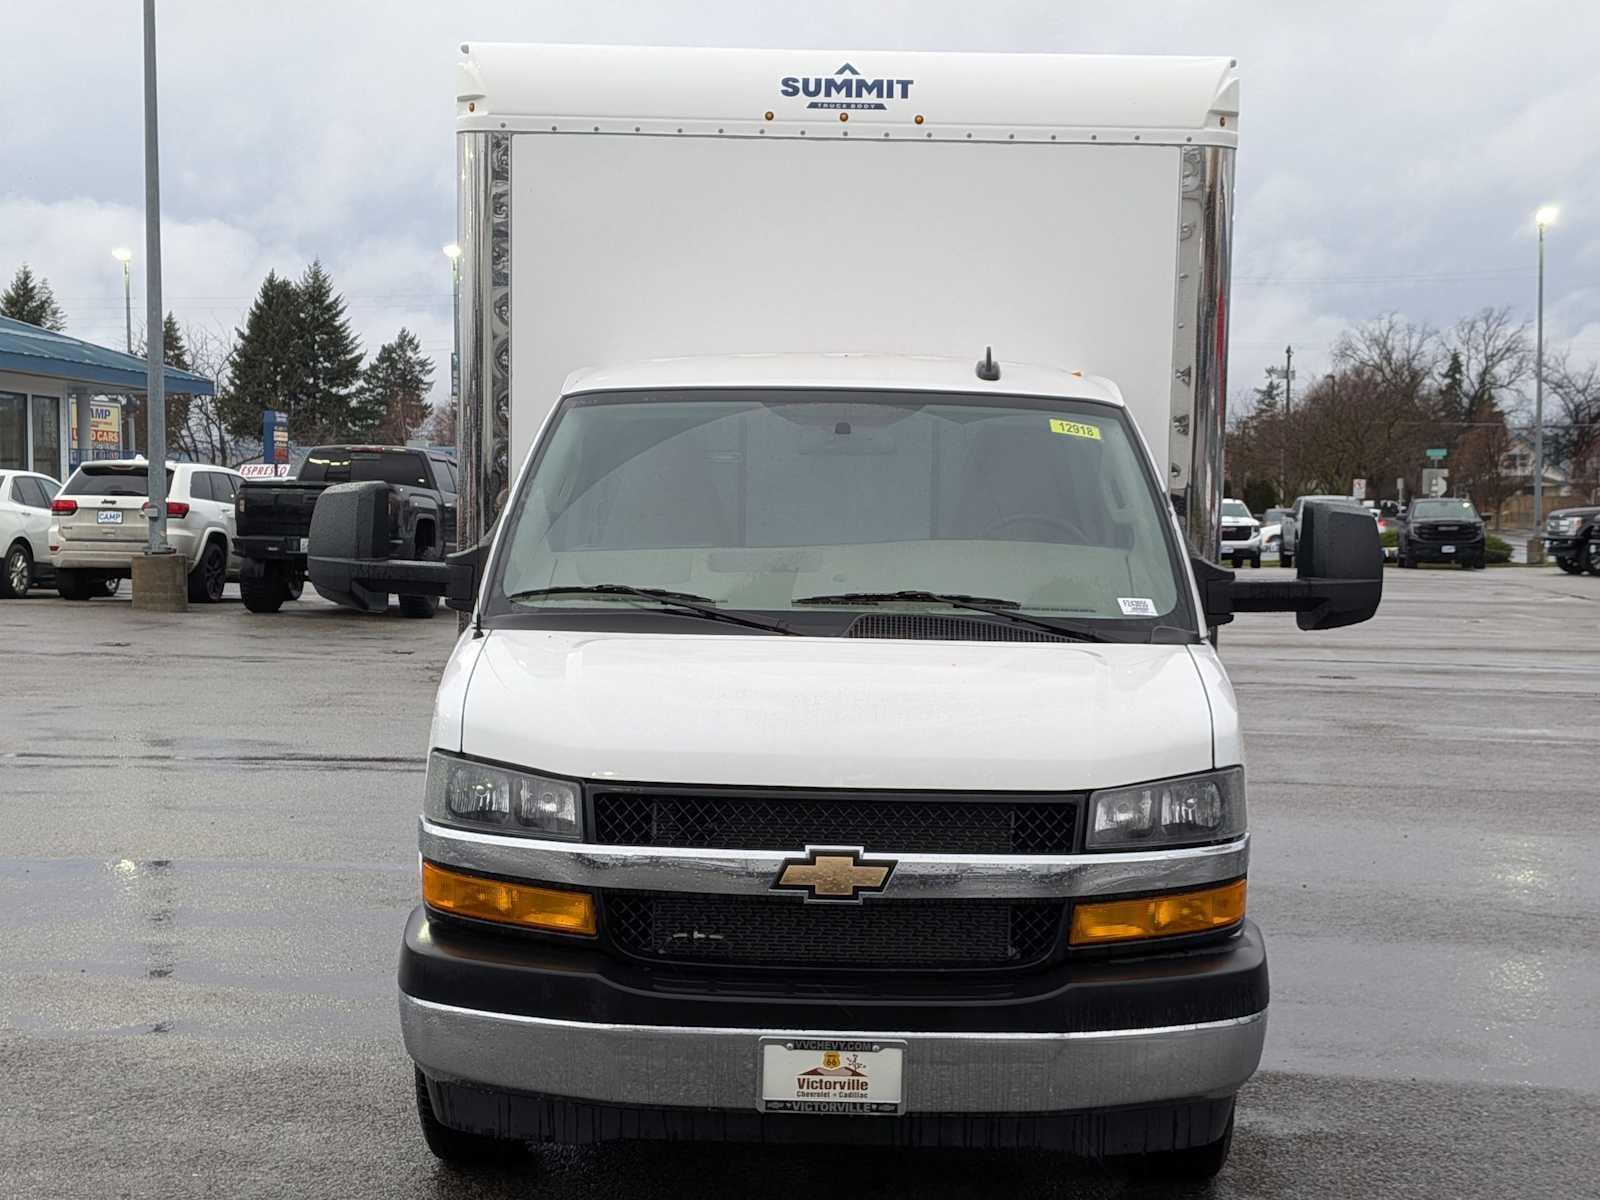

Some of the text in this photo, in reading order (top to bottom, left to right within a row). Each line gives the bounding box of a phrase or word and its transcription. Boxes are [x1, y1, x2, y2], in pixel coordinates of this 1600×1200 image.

[780, 77, 914, 99] SUMMIT
[90, 408, 111, 419] AMP
[97, 431, 119, 442] CARS
[241, 465, 288, 476] ESPRESO
[99, 512, 121, 520] CAMP
[826, 1057, 837, 1066] 66
[797, 1077, 869, 1091] Victorville
[796, 1090, 868, 1099] Chevrolet Cadillac
[792, 1101, 871, 1112] VICTORVILLE
